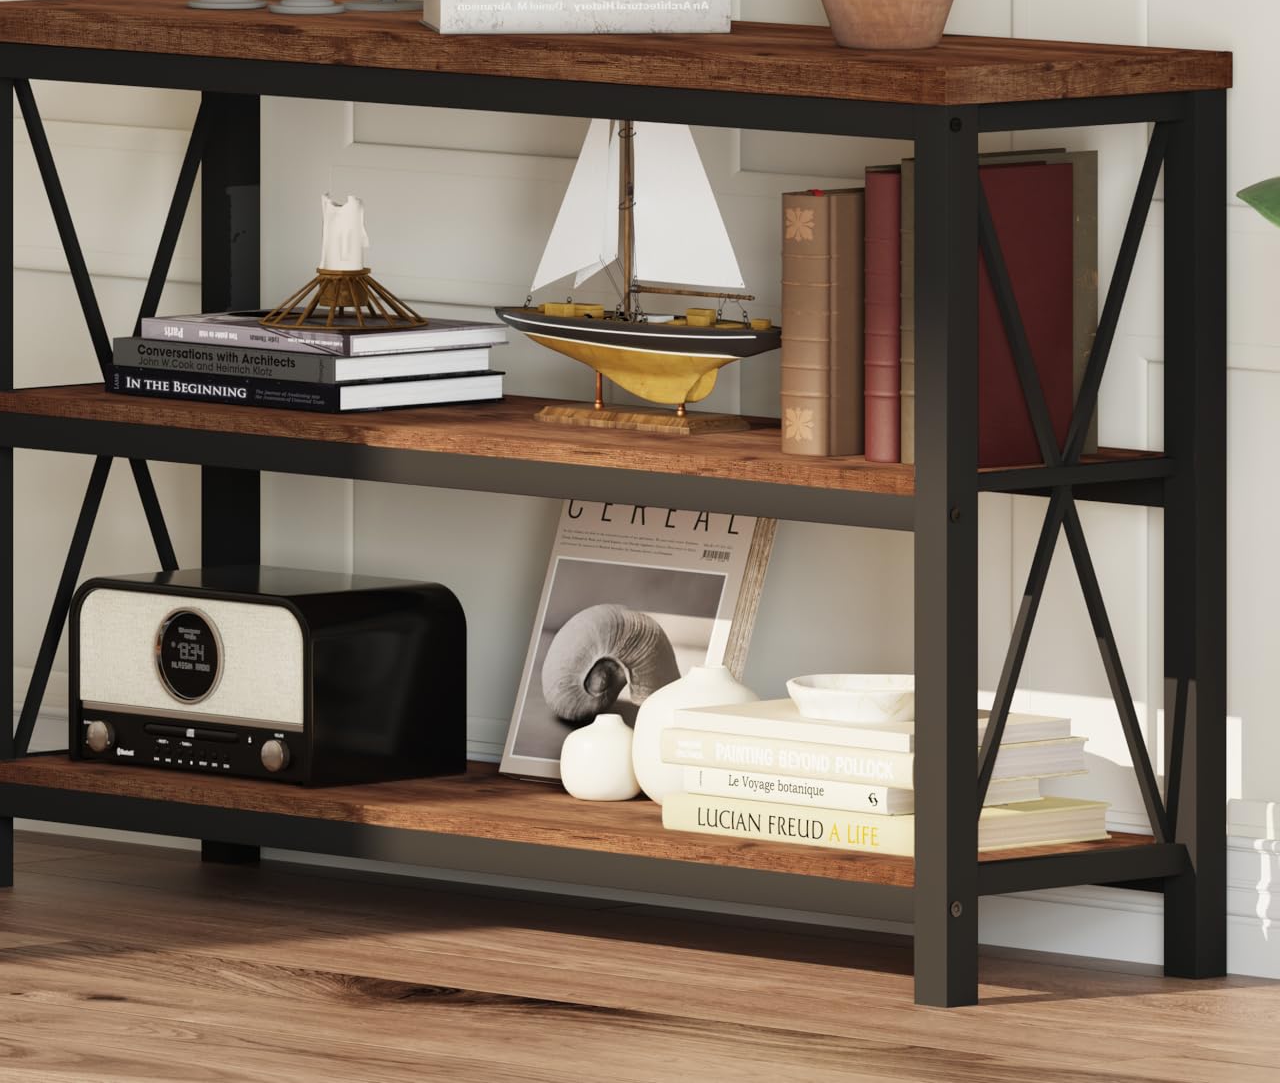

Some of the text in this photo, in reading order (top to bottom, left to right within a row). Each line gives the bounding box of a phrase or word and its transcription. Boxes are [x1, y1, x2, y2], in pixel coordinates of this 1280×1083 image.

[163, 326, 184, 338] Paris
[137, 344, 296, 368] Conversations with Architects
[138, 357, 160, 366] John
[196, 361, 214, 372] and
[215, 363, 251, 375] Heinrich
[252, 366, 273, 377] Klotz
[125, 376, 247, 398] IN THE BEGINNING
[568, 499, 739, 535] CEREAL
[715, 741, 772, 766] PAINTING
[778, 750, 831, 773] BEYOND
[835, 755, 894, 780] POLLOCK
[728, 774, 825, 797] Le Voyage botanique
[697, 806, 880, 847] LUCIAN FREUD A LIFE
